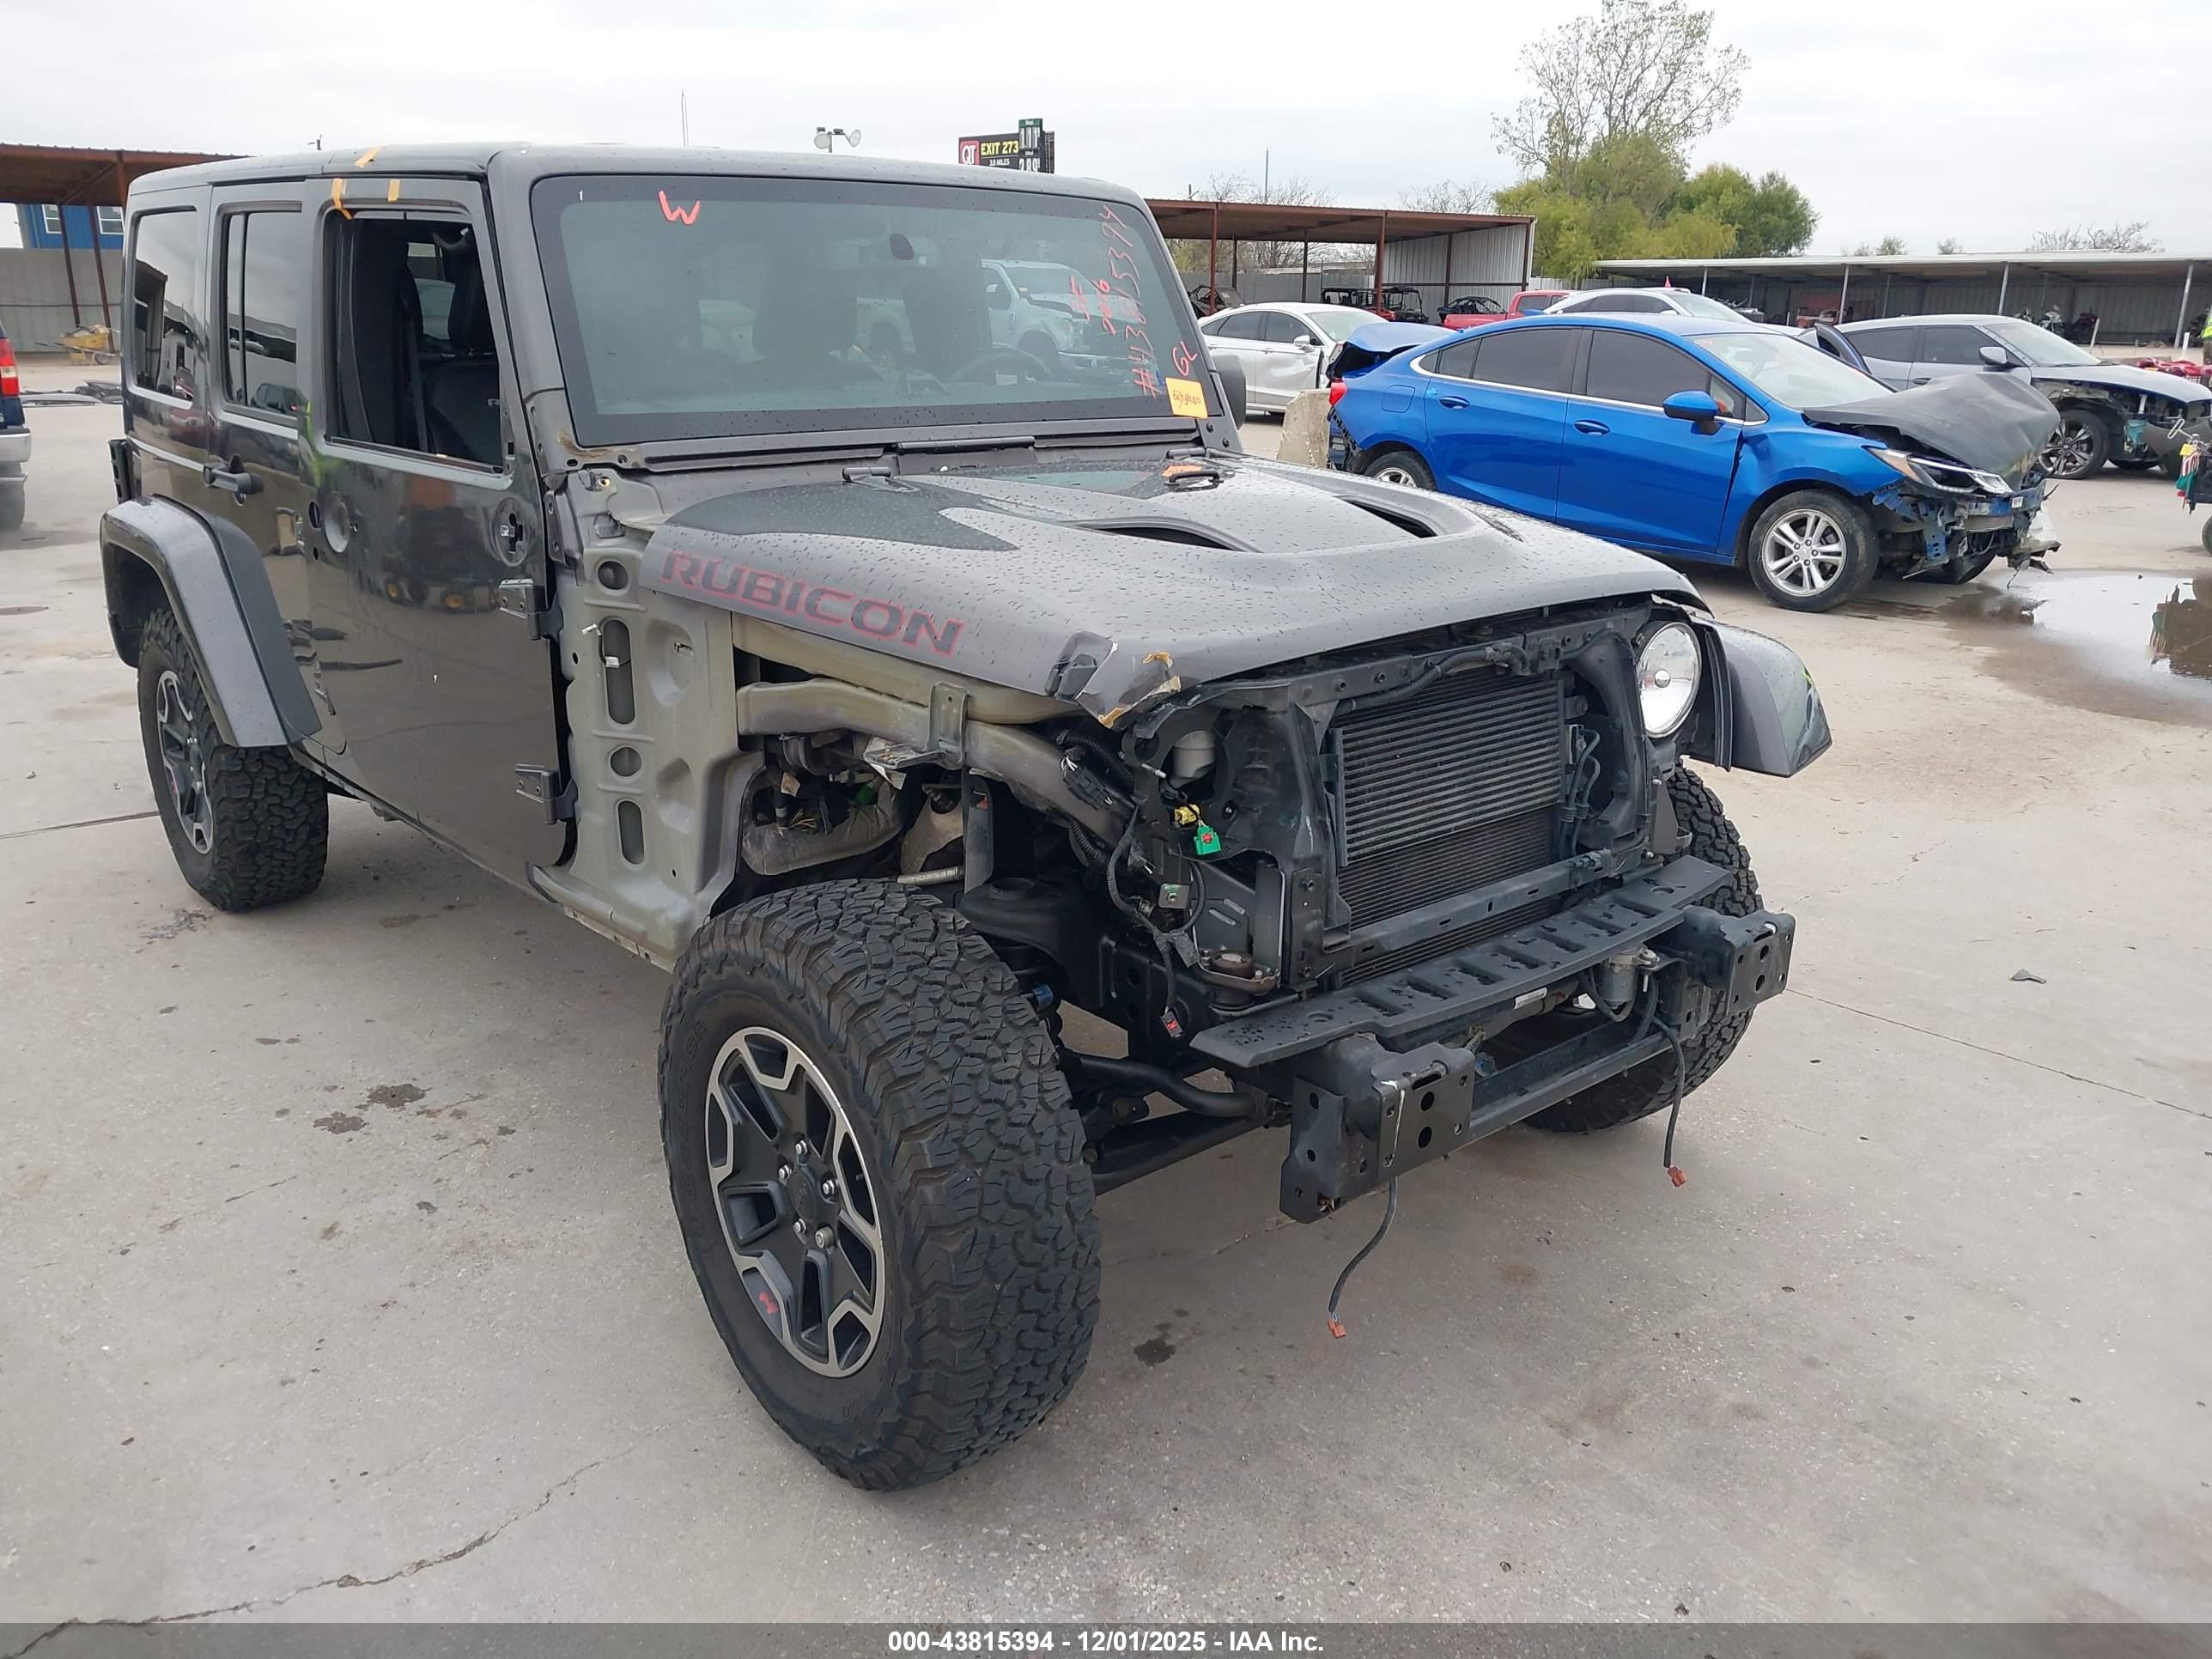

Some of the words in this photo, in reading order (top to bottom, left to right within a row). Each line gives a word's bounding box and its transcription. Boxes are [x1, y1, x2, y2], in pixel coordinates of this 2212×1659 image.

[962, 144, 975, 165] QT
[981, 142, 1000, 155] EXIT
[1002, 141, 1018, 155] 273
[659, 191, 701, 225] W
[660, 550, 965, 657] RUBICON
